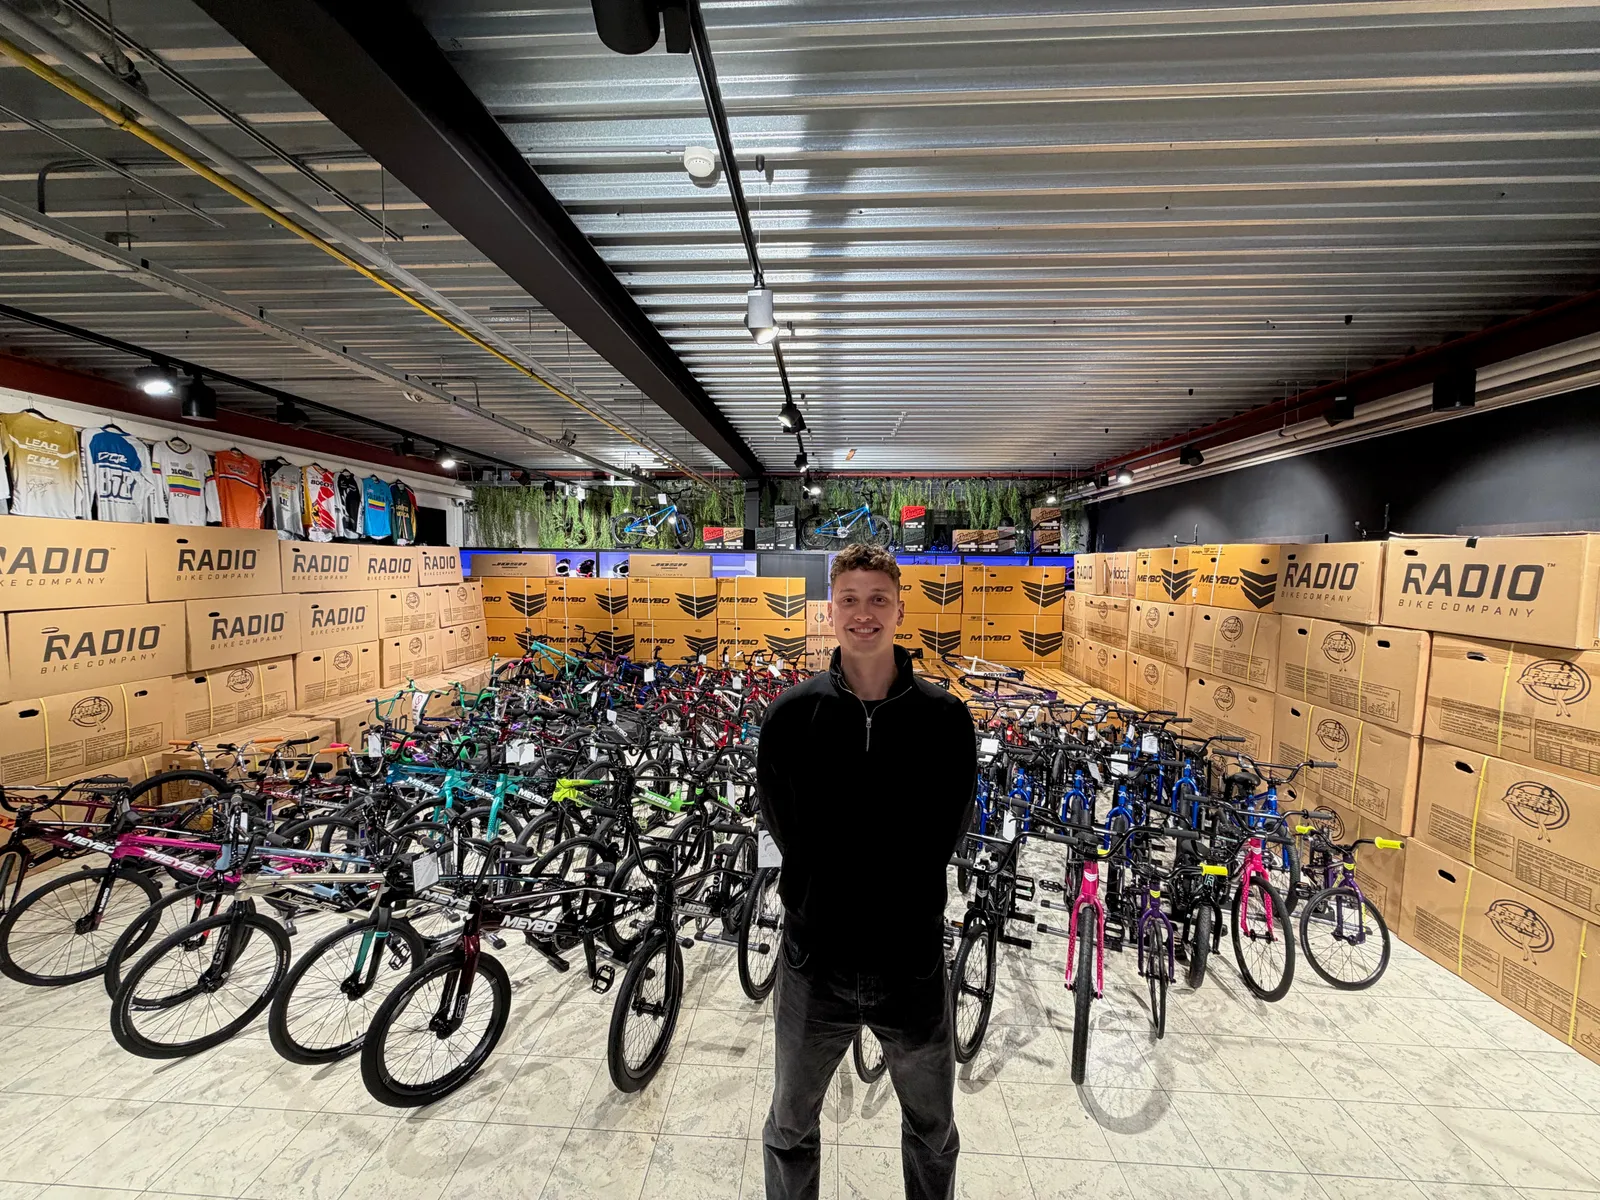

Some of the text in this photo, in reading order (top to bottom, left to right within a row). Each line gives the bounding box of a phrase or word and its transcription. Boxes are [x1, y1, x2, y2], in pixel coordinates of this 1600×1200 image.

[0, 546, 110, 575] ADIO
[178, 549, 257, 572] RADIO
[293, 554, 349, 573] RADIO
[368, 558, 412, 574] RADIO
[424, 555, 456, 571] RADIO
[26, 577, 105, 586] COMPANY
[176, 573, 256, 582] BIKE COMPANY
[1137, 574, 1162, 583] MEYBO
[1199, 574, 1240, 585] MEYBO
[1283, 562, 1359, 591] RADIO
[1402, 563, 1545, 601] RADIO
[1281, 590, 1352, 602] BIKE COMPANY
[311, 606, 366, 628] RADIO
[1398, 599, 1534, 618] BIKE COMPANY
[212, 612, 285, 641] RADIO
[330, 625, 365, 634] COMPANY
[43, 625, 160, 663] RADIO
[210, 635, 283, 650] BIKE COMPANY
[40, 652, 157, 675] BIKE COMPANY
[405, 776, 440, 795] MEYBO
[469, 786, 495, 800] MEYB
[517, 787, 549, 805] MEYBO
[63, 833, 116, 854] MEYBO
[144, 850, 208, 876] MEYBO
[419, 890, 471, 911] MEYB
[500, 915, 558, 933] MEYBO
